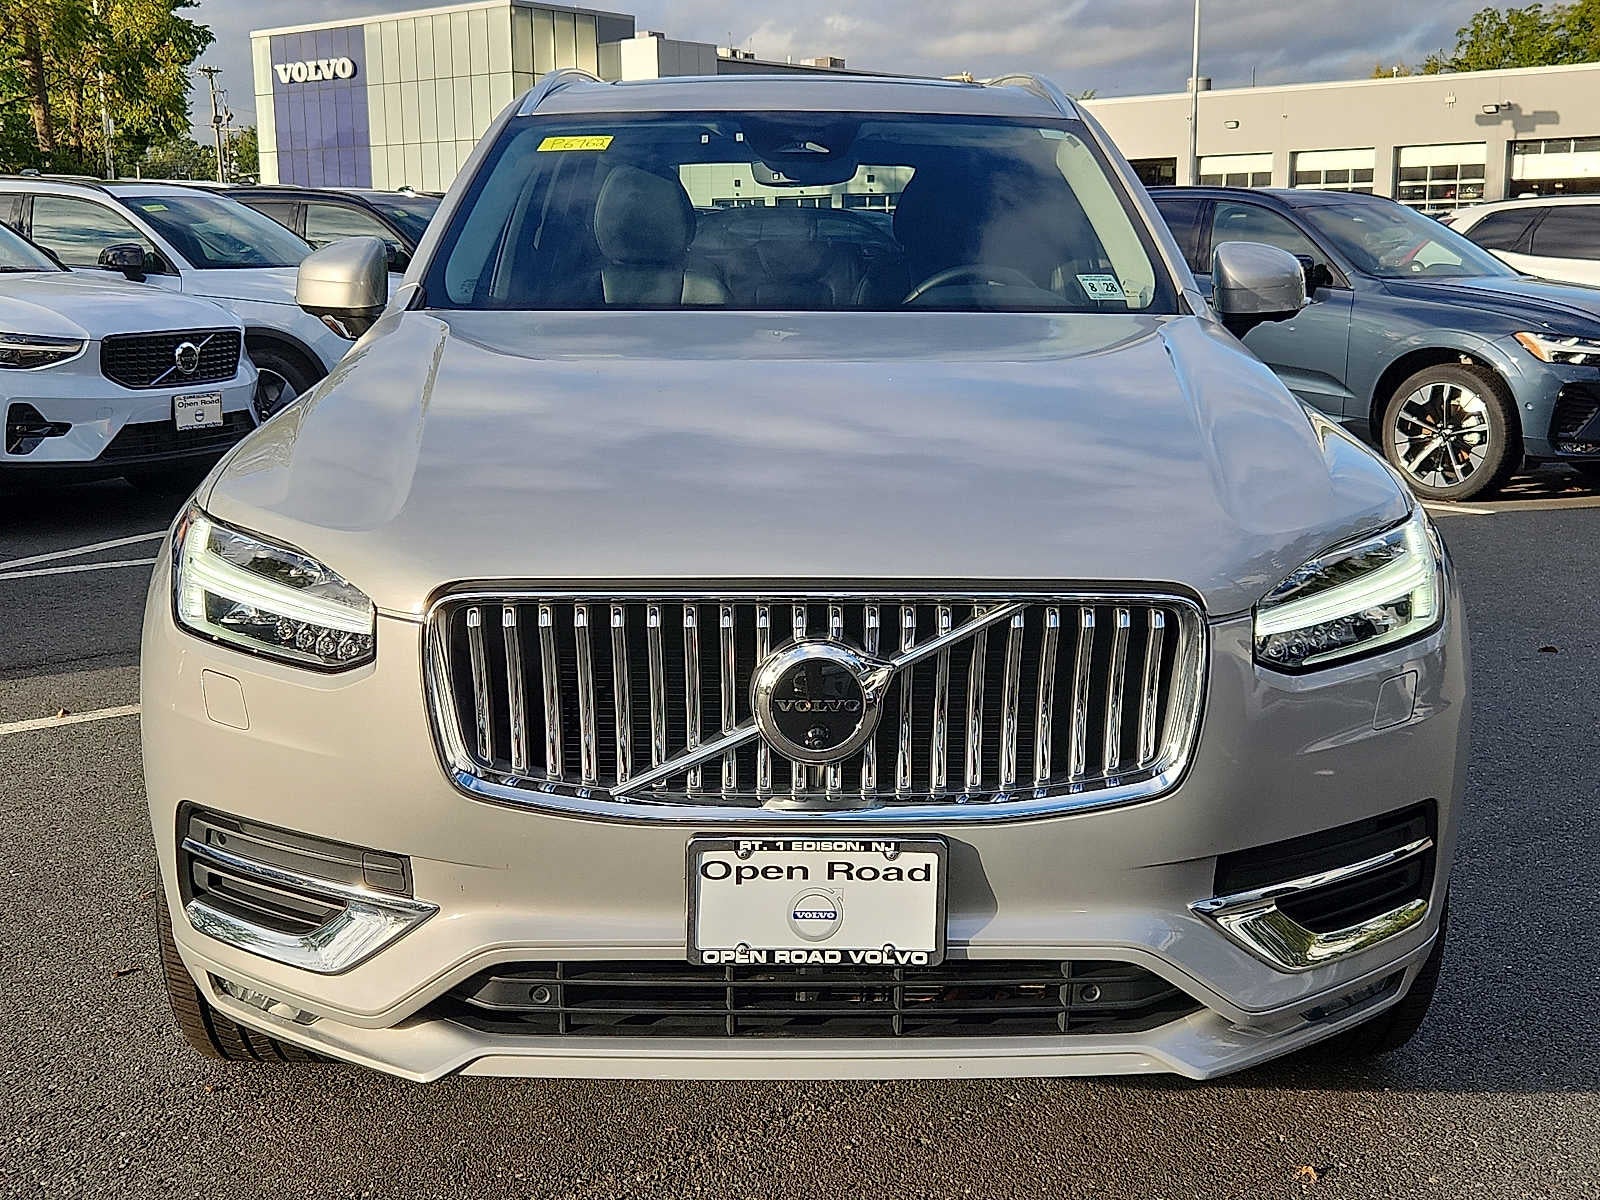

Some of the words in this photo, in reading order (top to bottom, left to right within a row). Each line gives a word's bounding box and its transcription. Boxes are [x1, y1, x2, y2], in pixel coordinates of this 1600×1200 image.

[273, 57, 354, 84] VOLVO
[1088, 283, 1098, 292] 8
[1103, 283, 1117, 292] 28
[774, 699, 860, 712] VOLVO
[739, 841, 768, 851] RT.
[775, 841, 784, 851] 1
[871, 841, 896, 852] NJ
[700, 861, 809, 885] Open
[827, 861, 931, 882] Road
[794, 911, 837, 920] VOLVO
[702, 950, 770, 965] OPEN
[774, 950, 842, 965] ROAD
[850, 950, 928, 965] VOLVO
